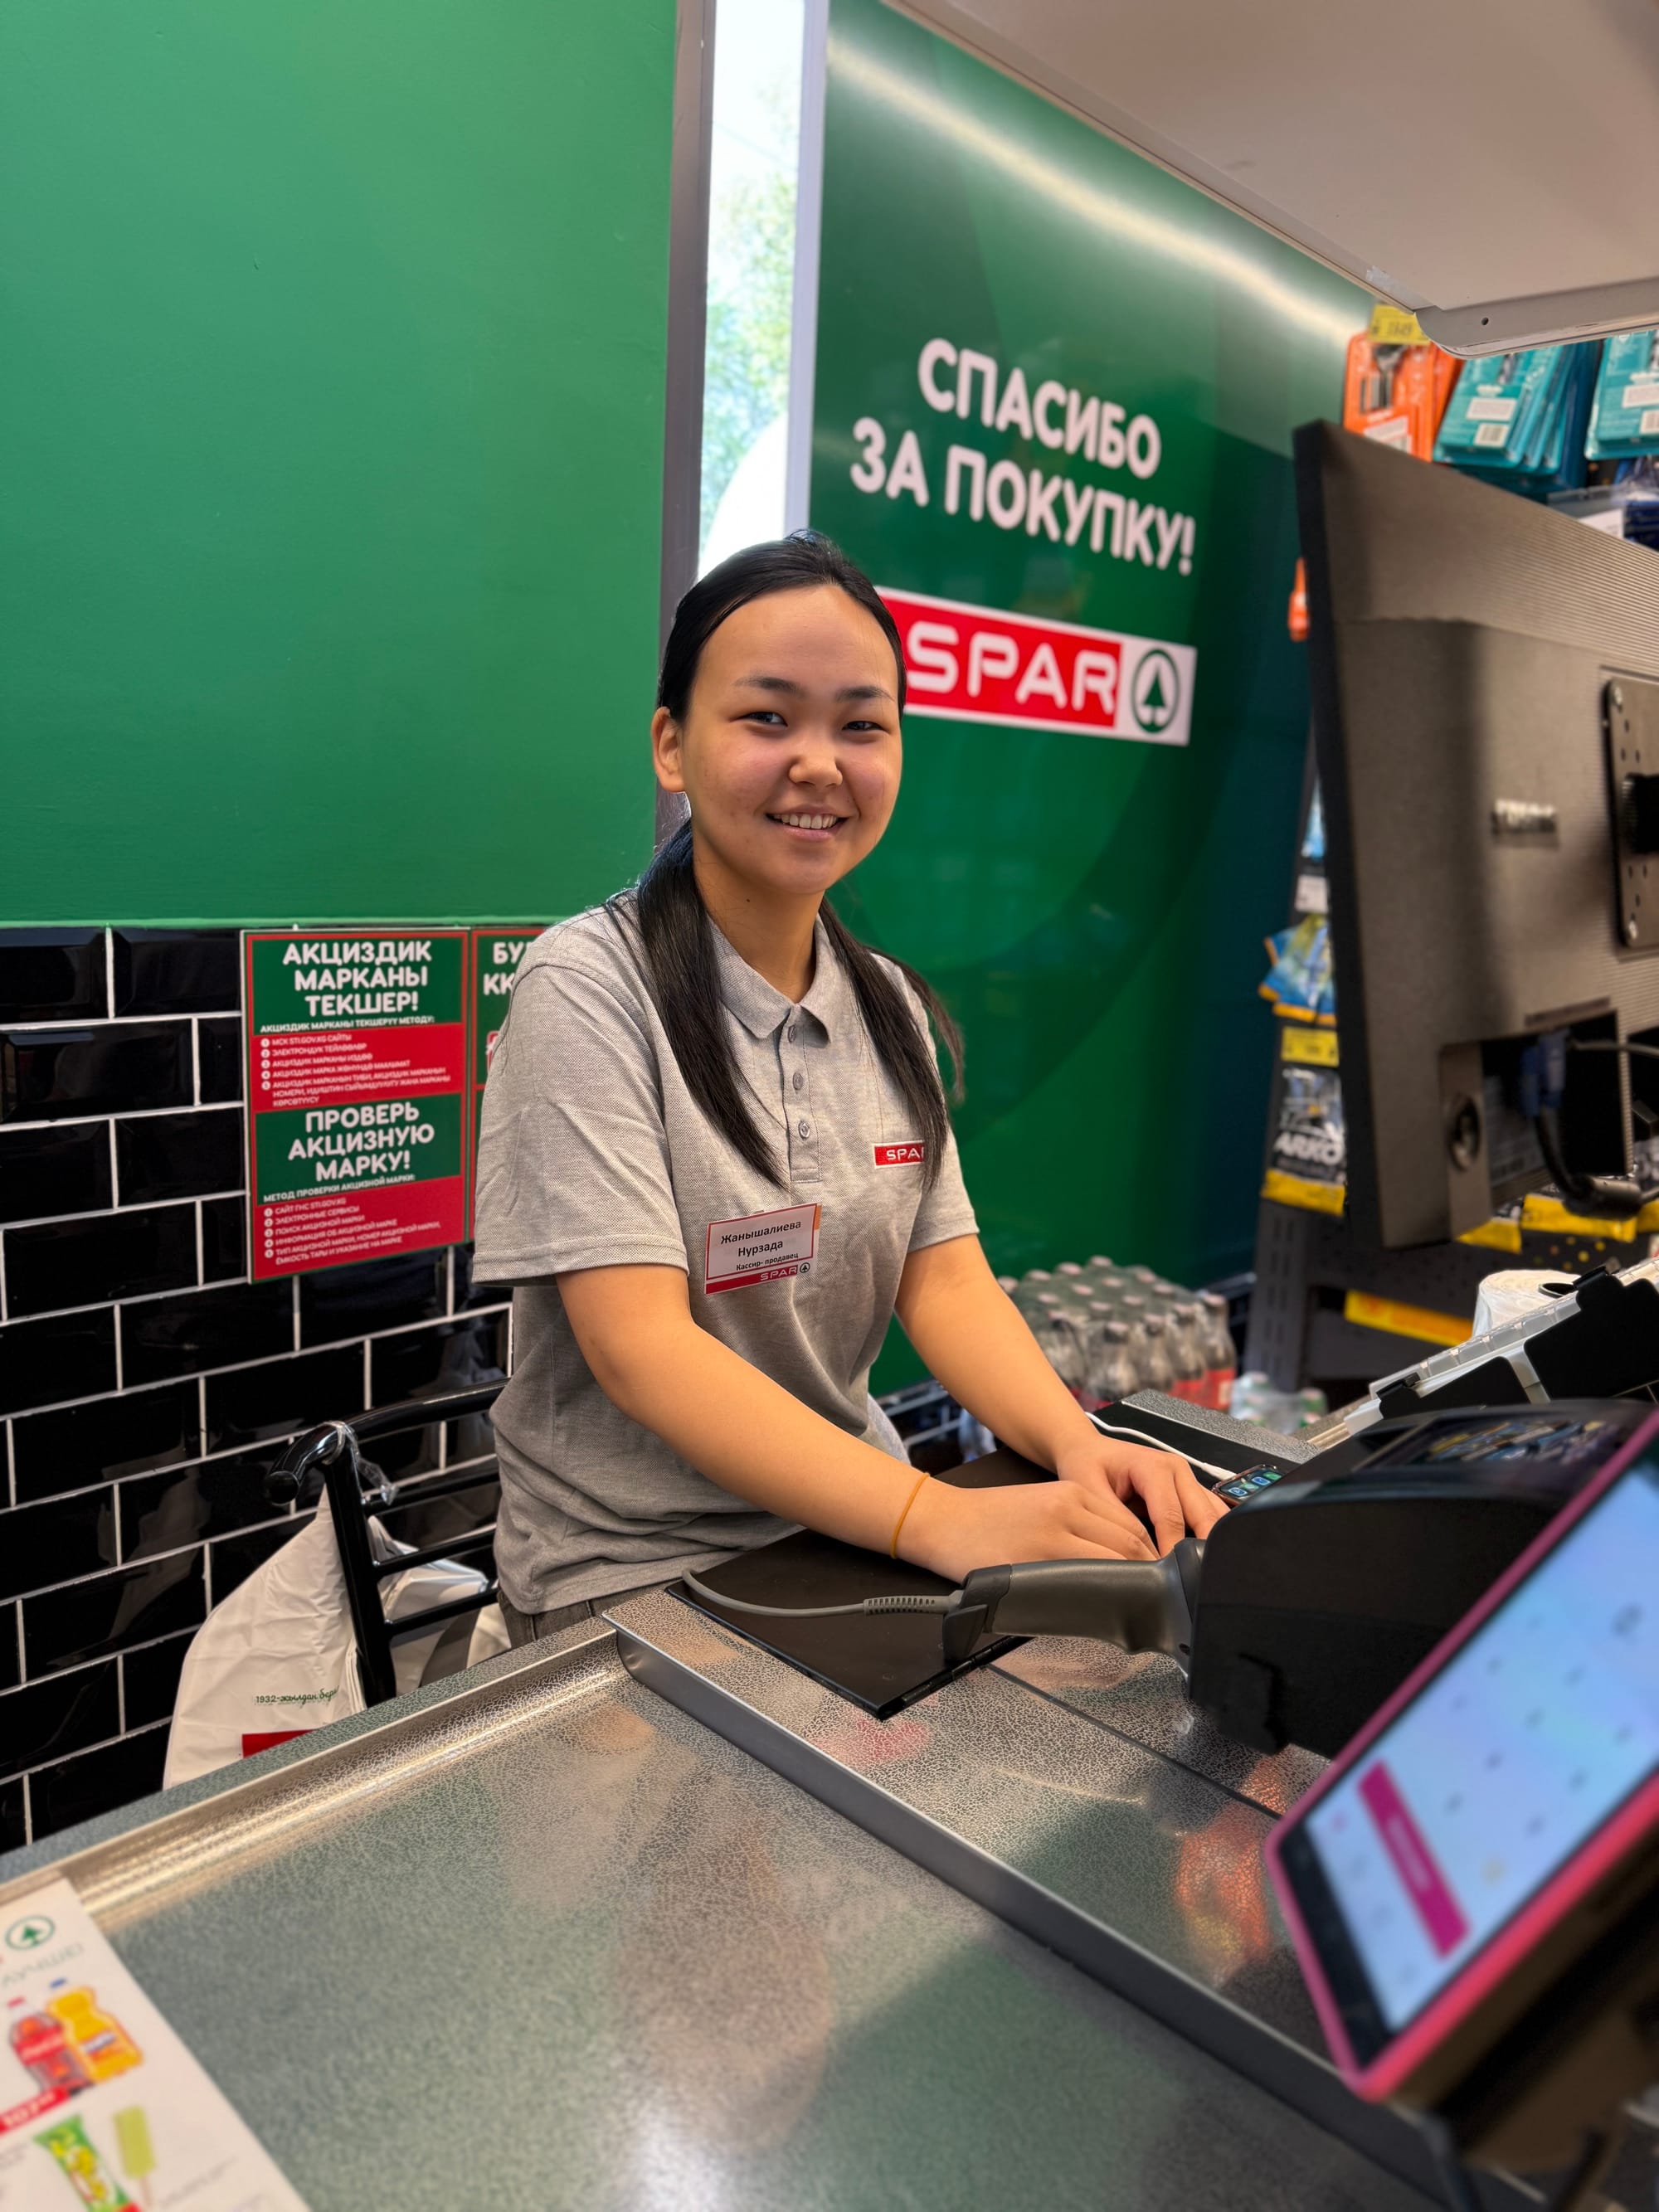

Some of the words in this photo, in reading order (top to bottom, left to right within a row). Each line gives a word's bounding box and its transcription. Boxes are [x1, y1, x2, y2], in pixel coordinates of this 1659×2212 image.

[917, 338, 1161, 479] СПАСИБО
[849, 417, 929, 508] ЗА
[944, 444, 1195, 576] ПОКУПКУ!
[907, 621, 1117, 715] SPAR
[282, 941, 432, 967] АКЦИЗДИК
[294, 966, 428, 991] МАРКАНЫ
[304, 991, 419, 1017] ТЕКШЕР!
[260, 1022, 310, 1033] АКЦИЗДИК
[311, 1019, 354, 1030] МАРКАНЫ
[305, 1101, 420, 1134] ПРОВЕРЬ
[288, 1123, 435, 1161] АКЦИЗНУЮ
[886, 1147, 924, 1161] SPA
[315, 1150, 411, 1182] МАРКУ!
[264, 1190, 295, 1203] МЕТОД
[296, 1184, 340, 1197] ПРОВЕРКИ
[720, 1221, 801, 1245] Жанышалиева
[737, 1260, 764, 1271] Кассир-
[765, 1252, 799, 1265] продавец
[738, 1241, 784, 1257] Нурзада
[760, 1266, 797, 1281] SPAR
